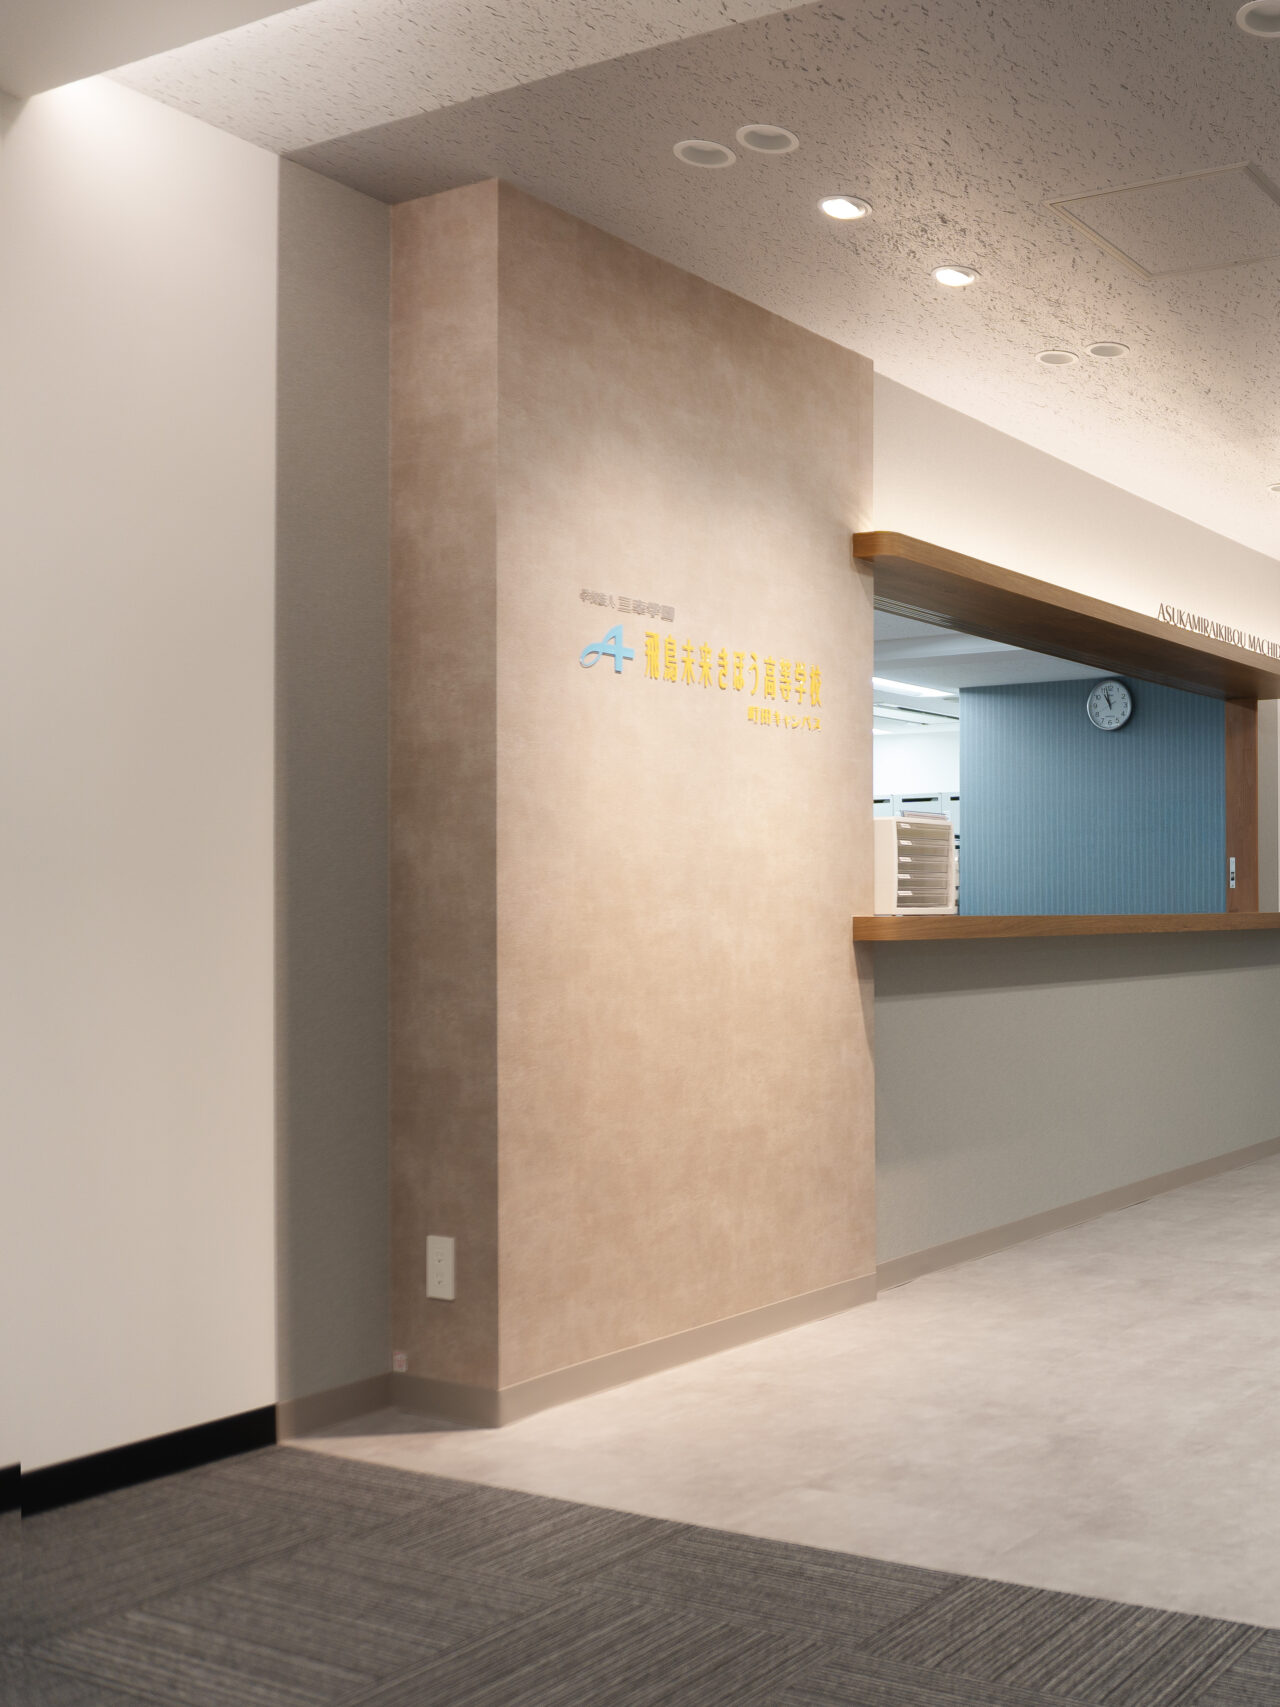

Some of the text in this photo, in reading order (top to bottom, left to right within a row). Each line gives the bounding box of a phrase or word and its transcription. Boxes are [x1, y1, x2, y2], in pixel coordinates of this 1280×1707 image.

[1157, 602, 1247, 648] ASUKAMIRAIKIBOU
[644, 631, 822, 708] 飛鳥未来きぼう高等学校
